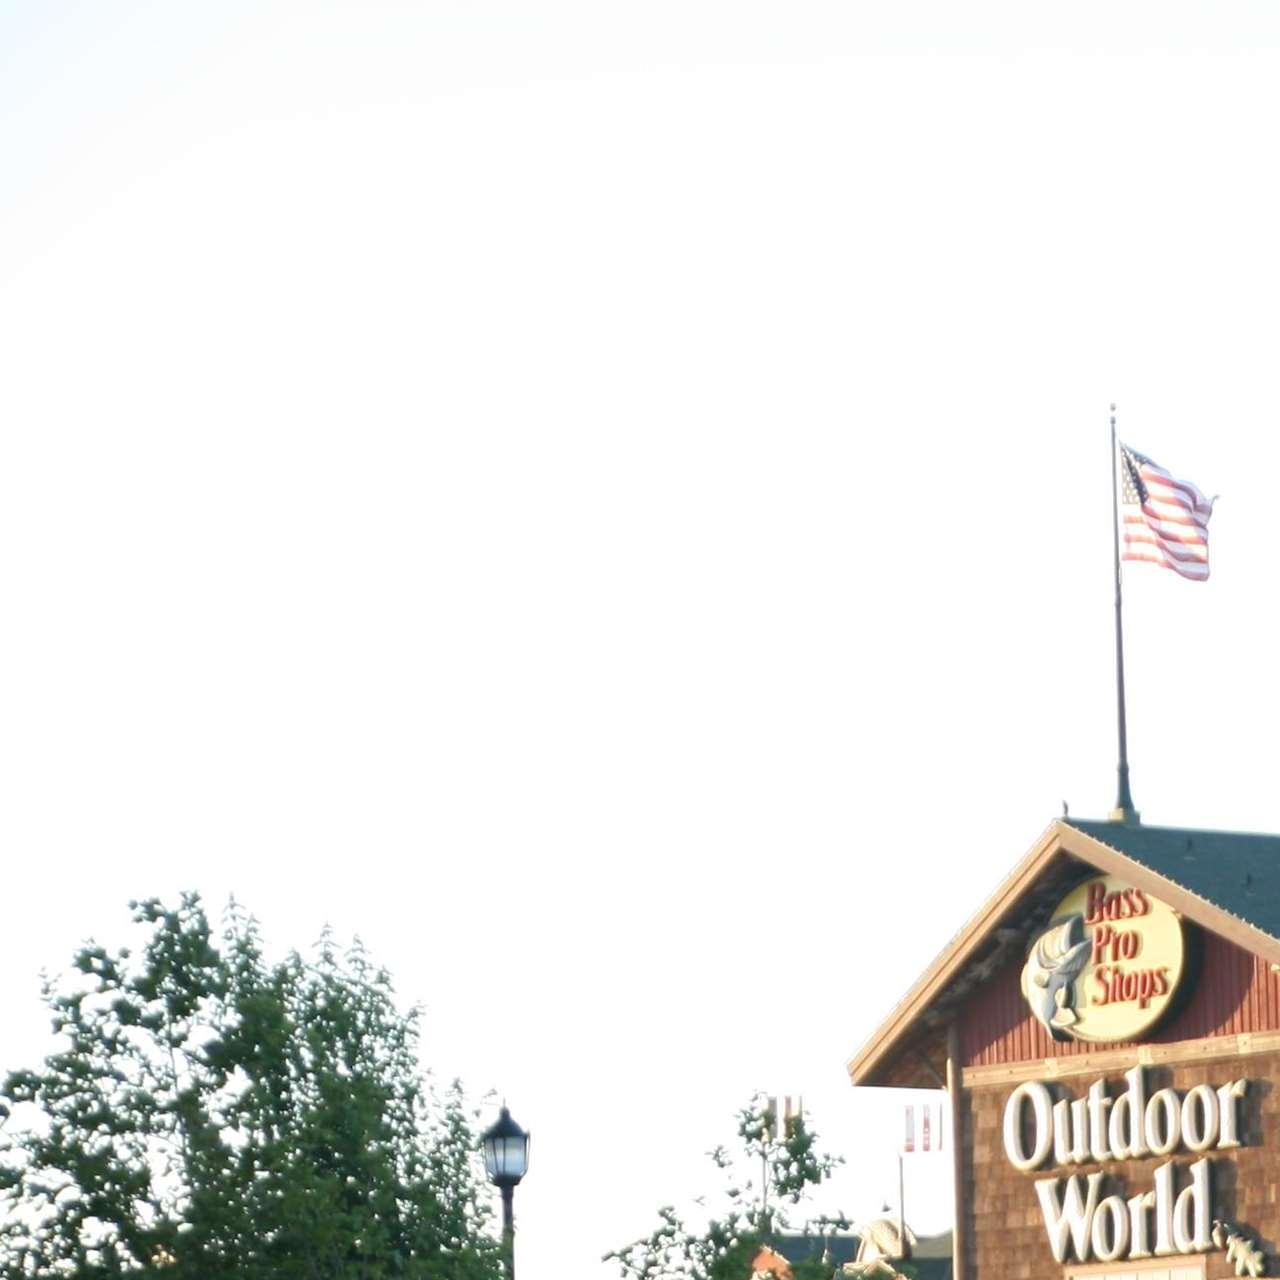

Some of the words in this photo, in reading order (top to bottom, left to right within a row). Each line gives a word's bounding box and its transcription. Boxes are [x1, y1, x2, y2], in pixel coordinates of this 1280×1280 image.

[1084, 881, 1150, 925] Bass
[1091, 924, 1141, 965] Pro
[1091, 963, 1170, 1009] Shops
[1003, 1065, 1248, 1172] Outdoor
[1034, 1157, 1213, 1263] World
